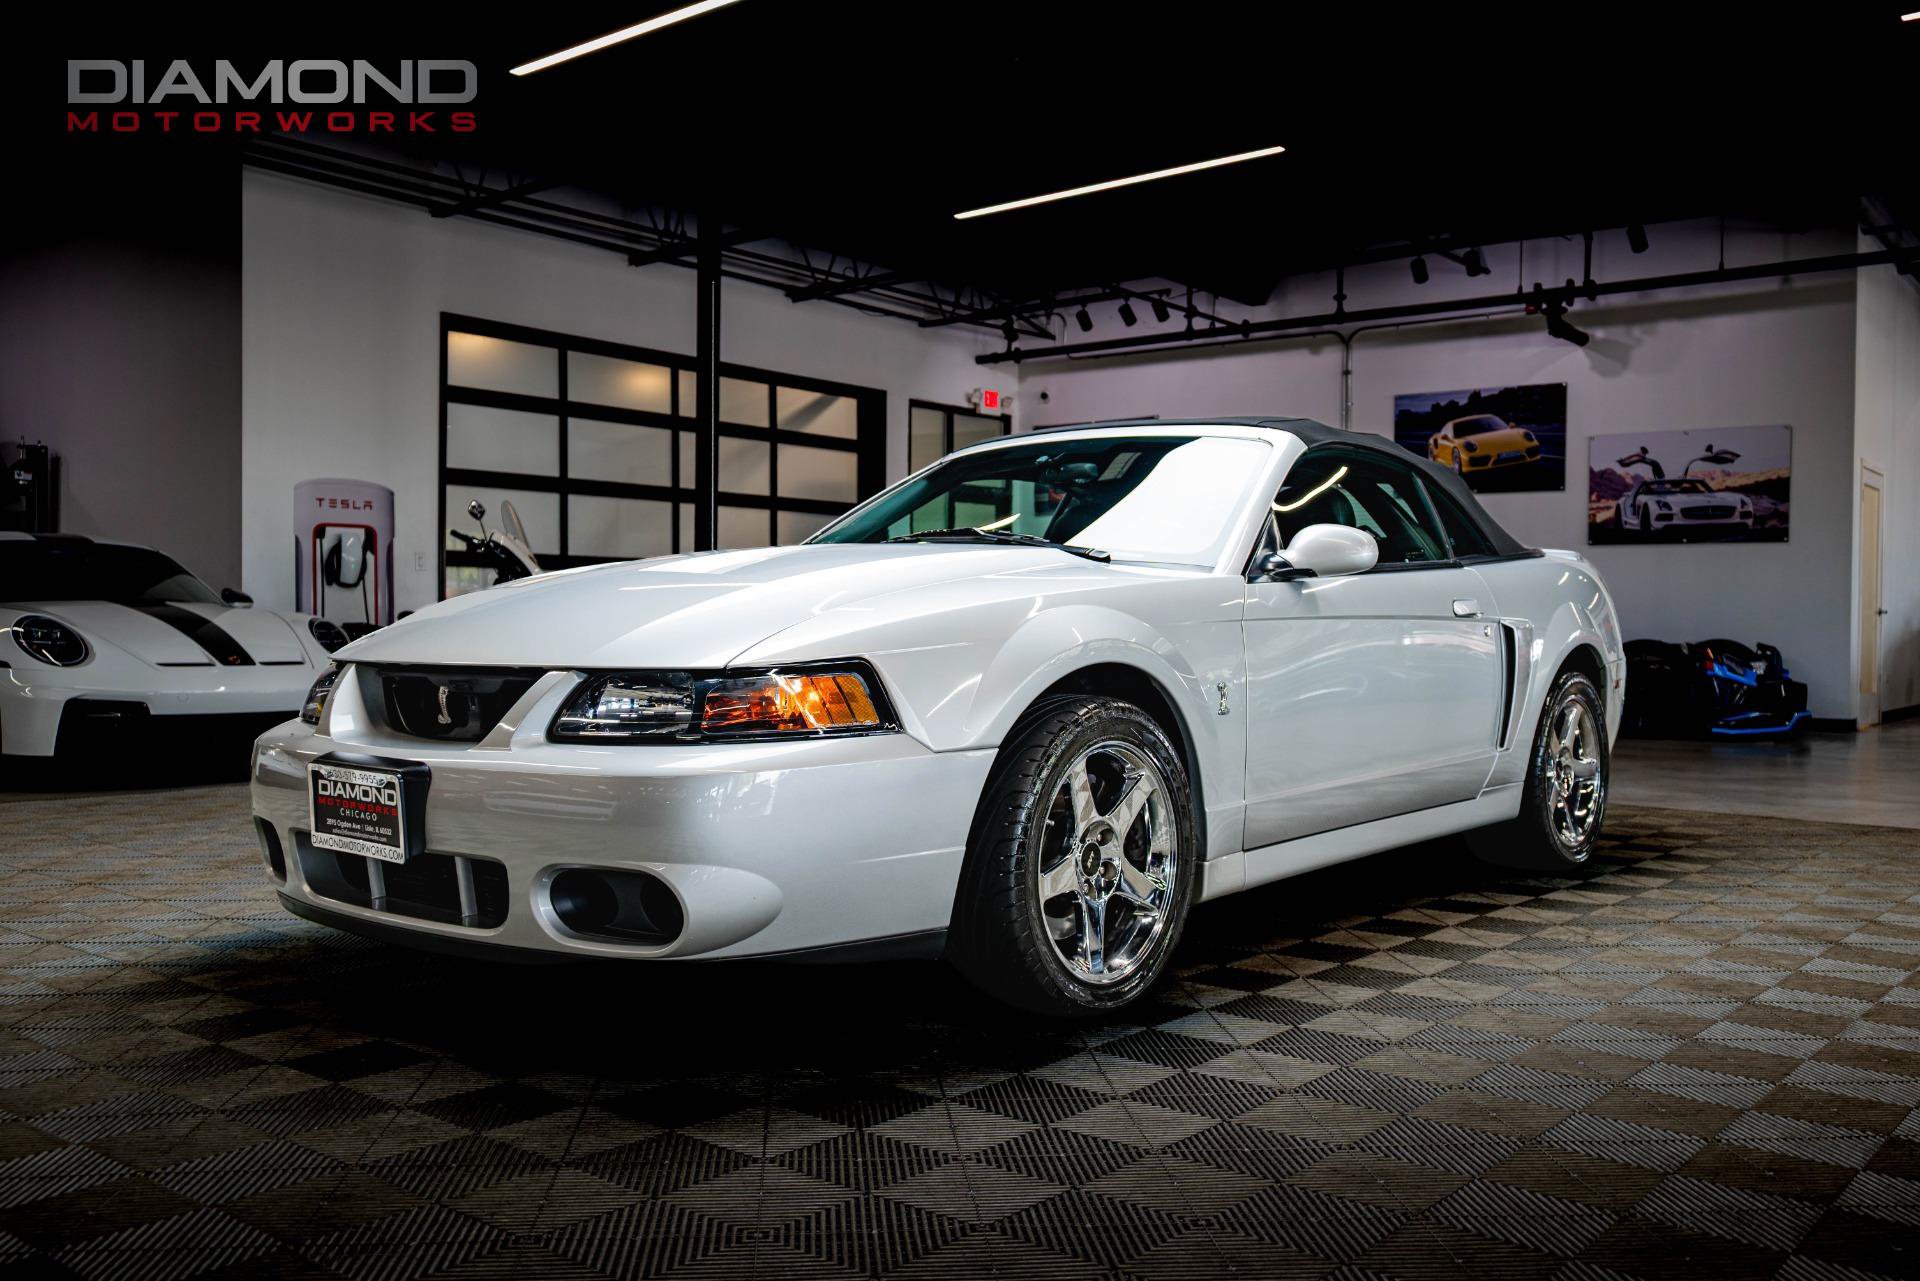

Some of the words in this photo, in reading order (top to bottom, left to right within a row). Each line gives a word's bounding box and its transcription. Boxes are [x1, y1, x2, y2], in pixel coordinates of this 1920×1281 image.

[315, 497, 373, 510] TESLA
[319, 780, 396, 806] DIAMOND
[319, 797, 398, 816] MOTORWORKS
[340, 808, 377, 821] CHICAGO
[312, 834, 403, 860] DIAMONDMOTORWORKS.COM
